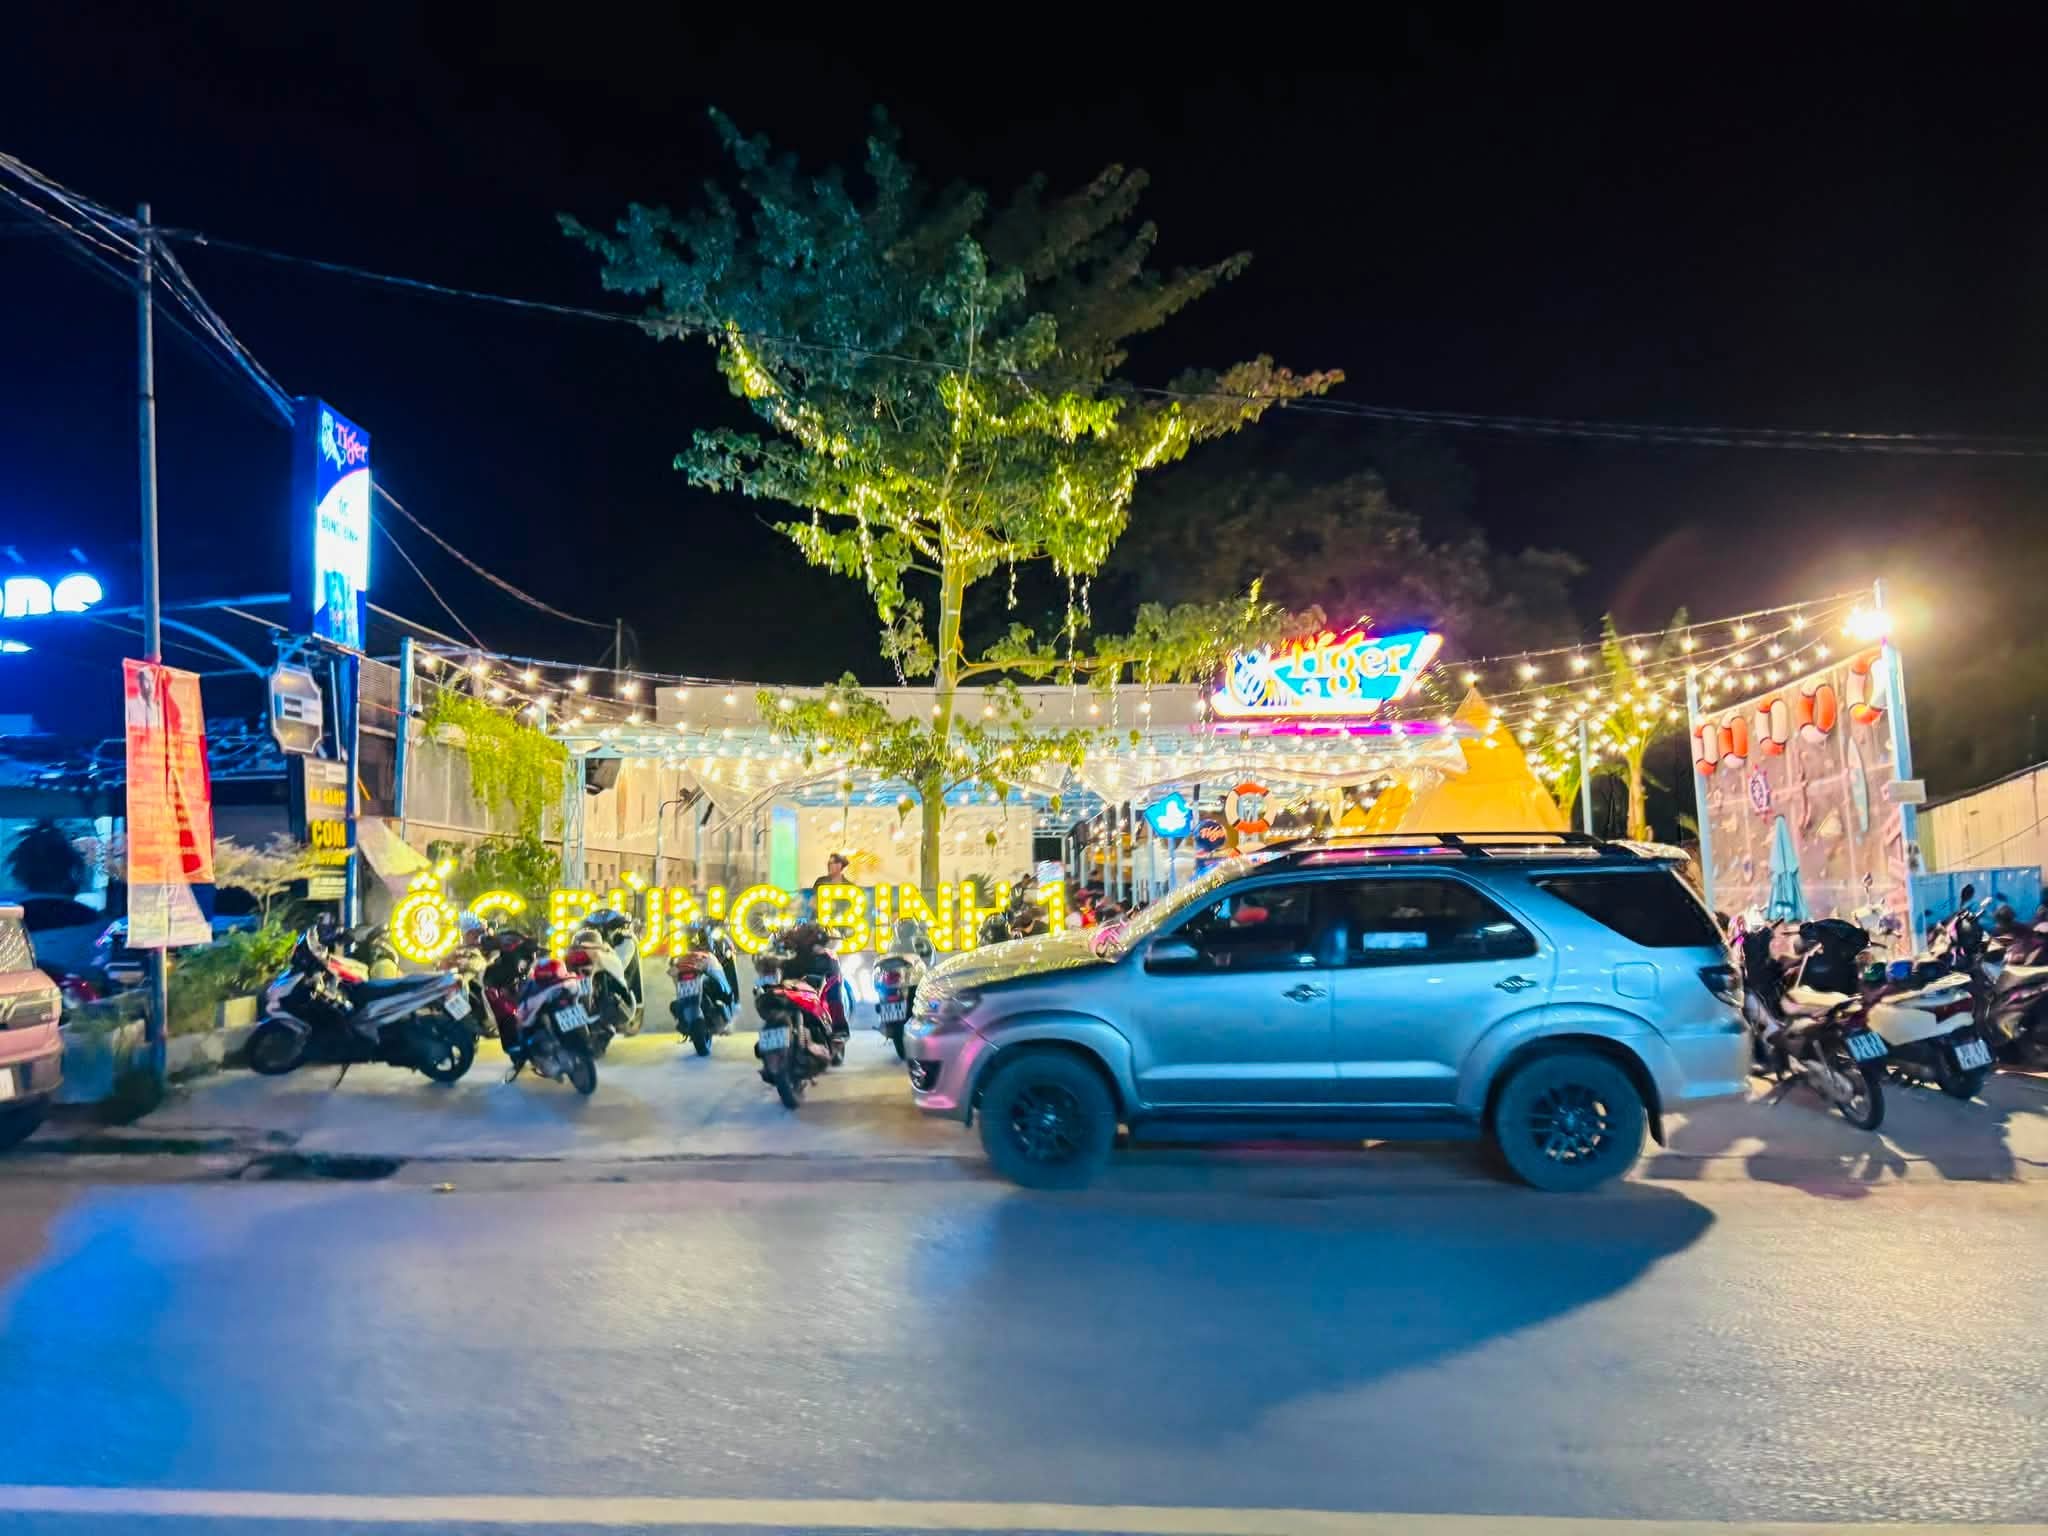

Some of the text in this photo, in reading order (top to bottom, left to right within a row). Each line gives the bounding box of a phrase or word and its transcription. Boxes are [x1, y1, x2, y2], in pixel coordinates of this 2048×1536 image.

[335, 421, 369, 465] Tiger
[0, 573, 103, 618] ne
[1287, 632, 1412, 699] Tiger
[817, 881, 1010, 954] BINH
[1038, 881, 1065, 936] 1
